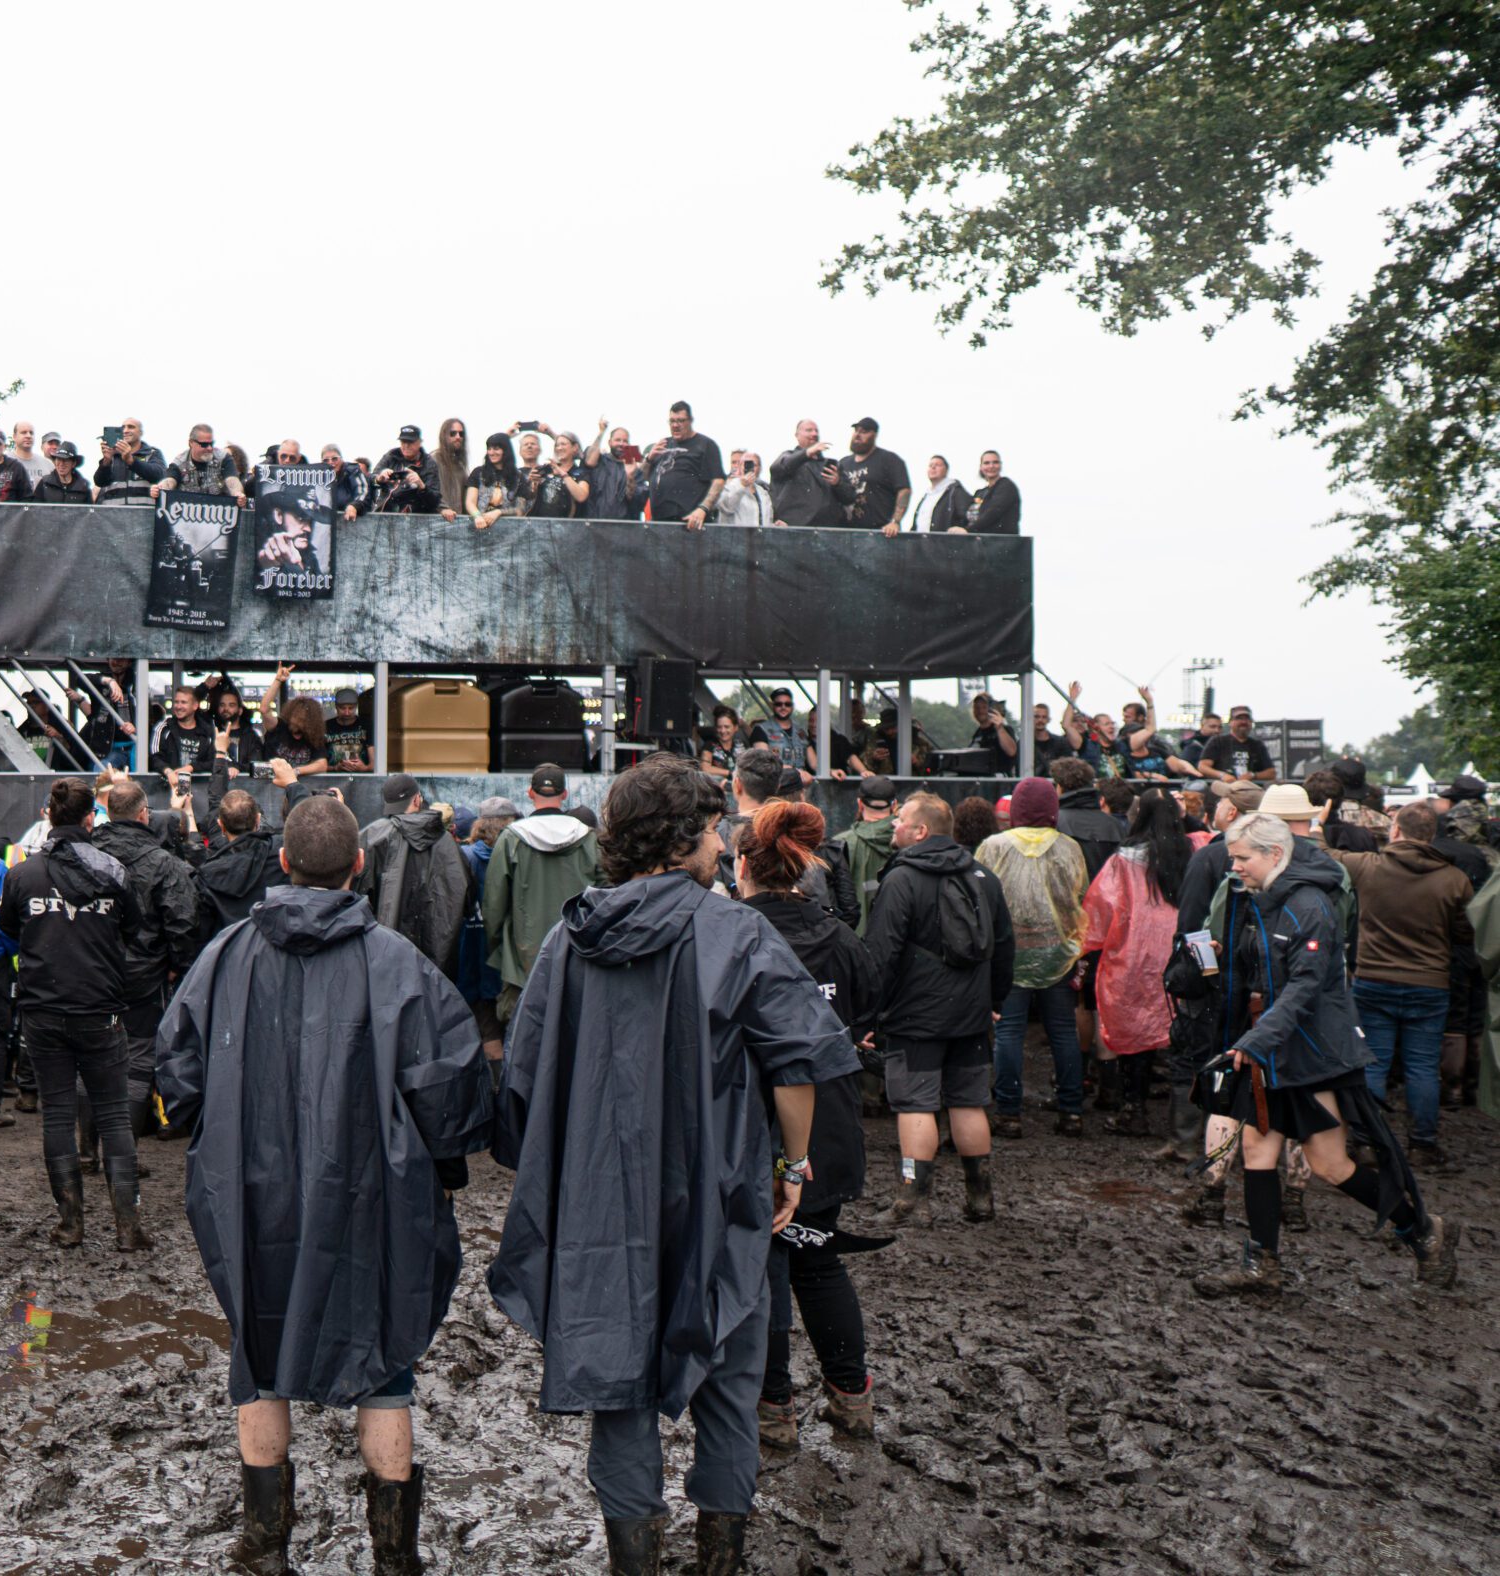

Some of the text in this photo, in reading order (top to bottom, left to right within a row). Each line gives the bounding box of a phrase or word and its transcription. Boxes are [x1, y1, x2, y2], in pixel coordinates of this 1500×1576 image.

[259, 465, 336, 491] Lemmy
[156, 490, 239, 535] Lemmy
[256, 566, 333, 590] Forever
[168, 608, 184, 617] 1945
[190, 610, 207, 619] 2015
